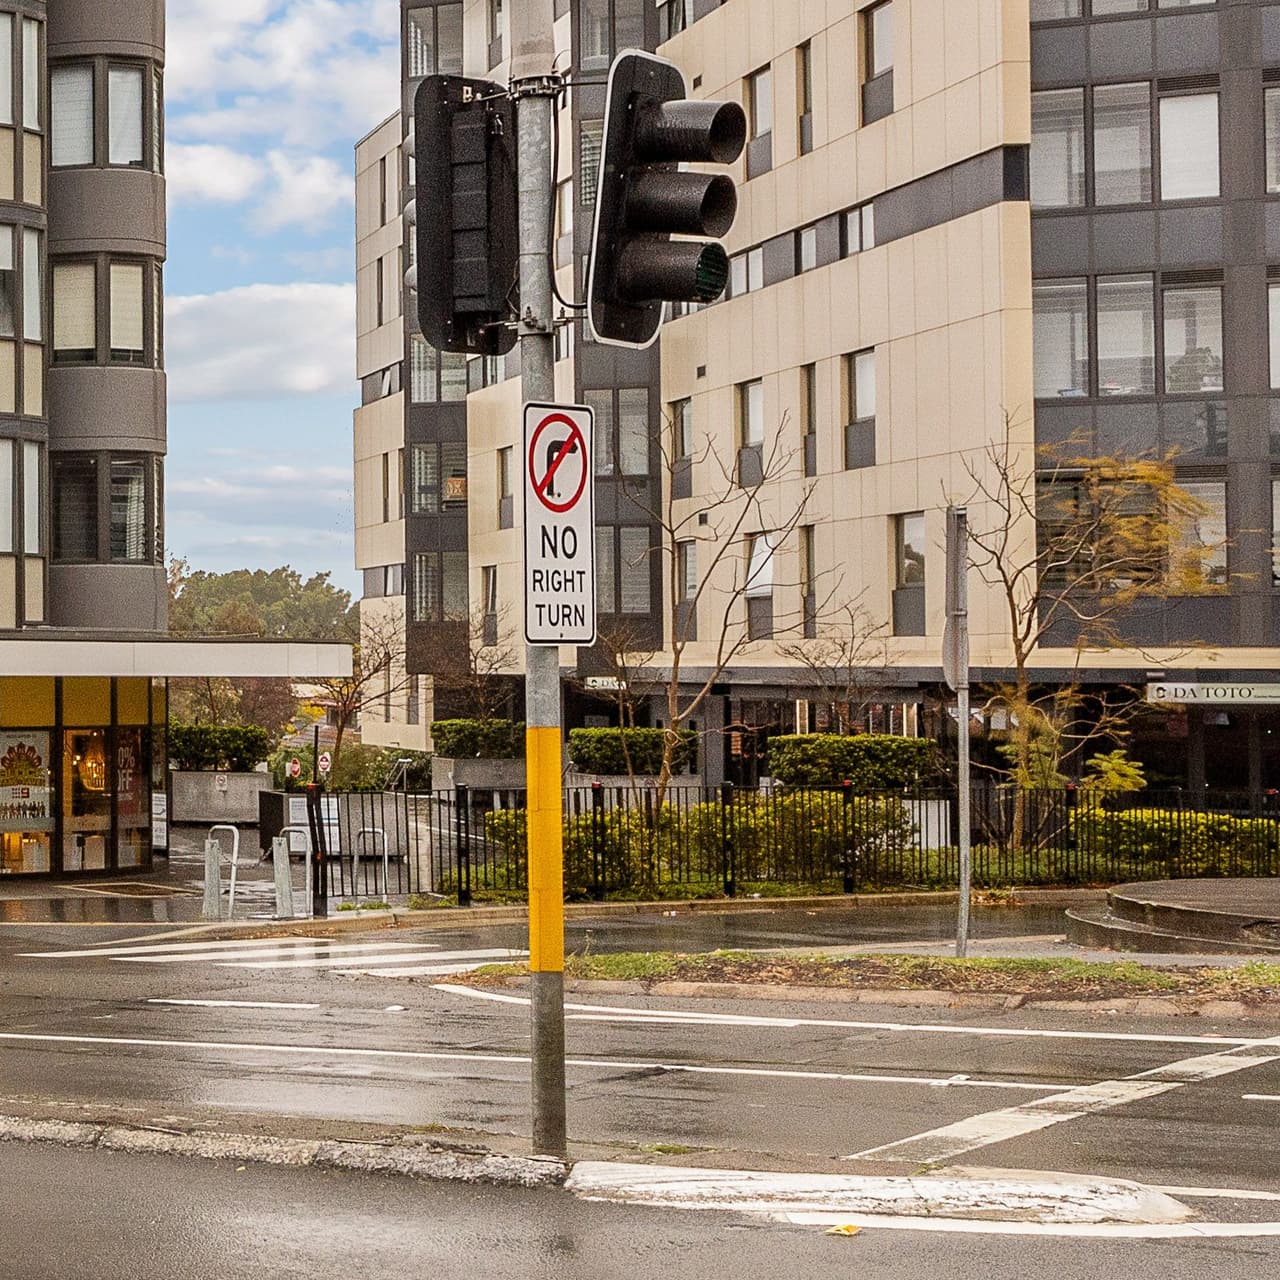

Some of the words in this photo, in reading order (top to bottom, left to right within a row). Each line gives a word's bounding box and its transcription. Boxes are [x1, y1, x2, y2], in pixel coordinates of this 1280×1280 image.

[541, 525, 577, 559] NO
[533, 570, 586, 592] RIGHT
[535, 604, 585, 626] TURN
[1173, 687, 1197, 698] DA
